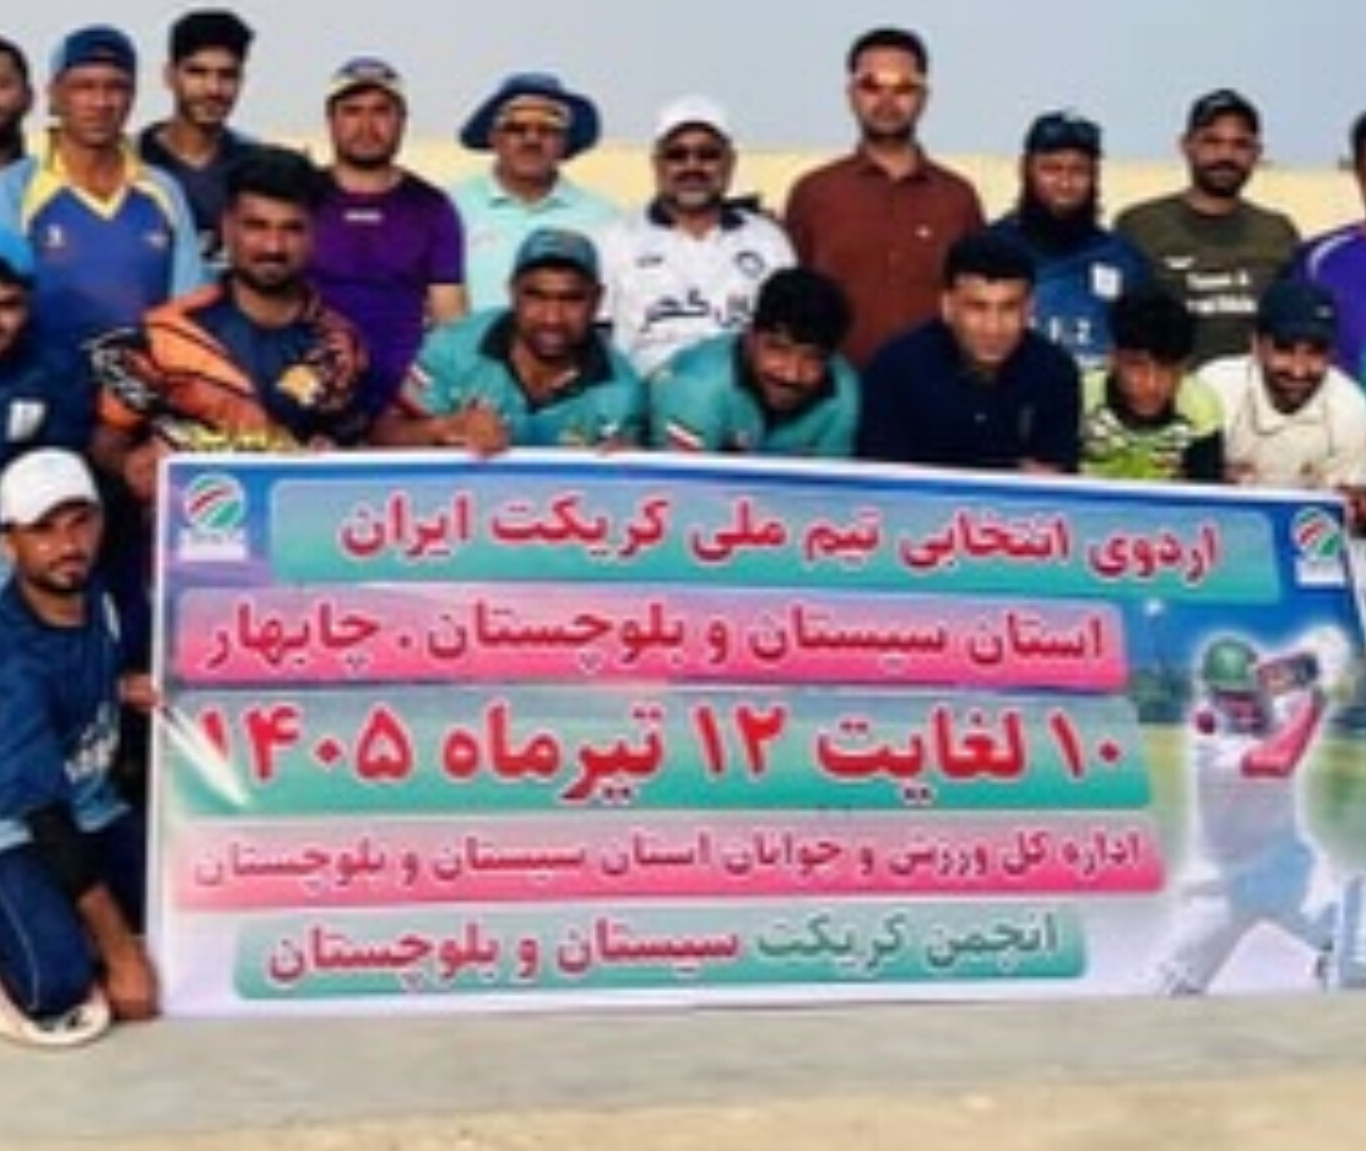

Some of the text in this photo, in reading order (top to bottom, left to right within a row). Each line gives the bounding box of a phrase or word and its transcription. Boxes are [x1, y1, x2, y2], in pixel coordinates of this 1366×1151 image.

[342, 495, 1219, 582] اردوی انتخابی تیم ملی کریکت ایران
[207, 603, 381, 670] چابهار
[428, 601, 683, 671] بلوچستان
[708, 621, 728, 665] و
[748, 604, 946, 668] سیستان
[970, 612, 1103, 666] استان
[200, 706, 413, 782] ۱۴۰۵
[443, 704, 665, 801] تیرماه
[694, 705, 788, 776] ۱۲
[817, 707, 1026, 802] لغایت
[1050, 711, 1123, 779] ۱۰
[195, 839, 385, 892] بلوچستان
[402, 849, 420, 886] و
[434, 836, 586, 881] سیستان
[601, 831, 710, 877] استان
[860, 847, 874, 876] و
[888, 832, 989, 877] ورزش
[1003, 831, 1048, 876] کل
[1061, 832, 1140, 876] اداره
[268, 911, 1058, 988] انجمن کریکت سیستان و بلوچستان
